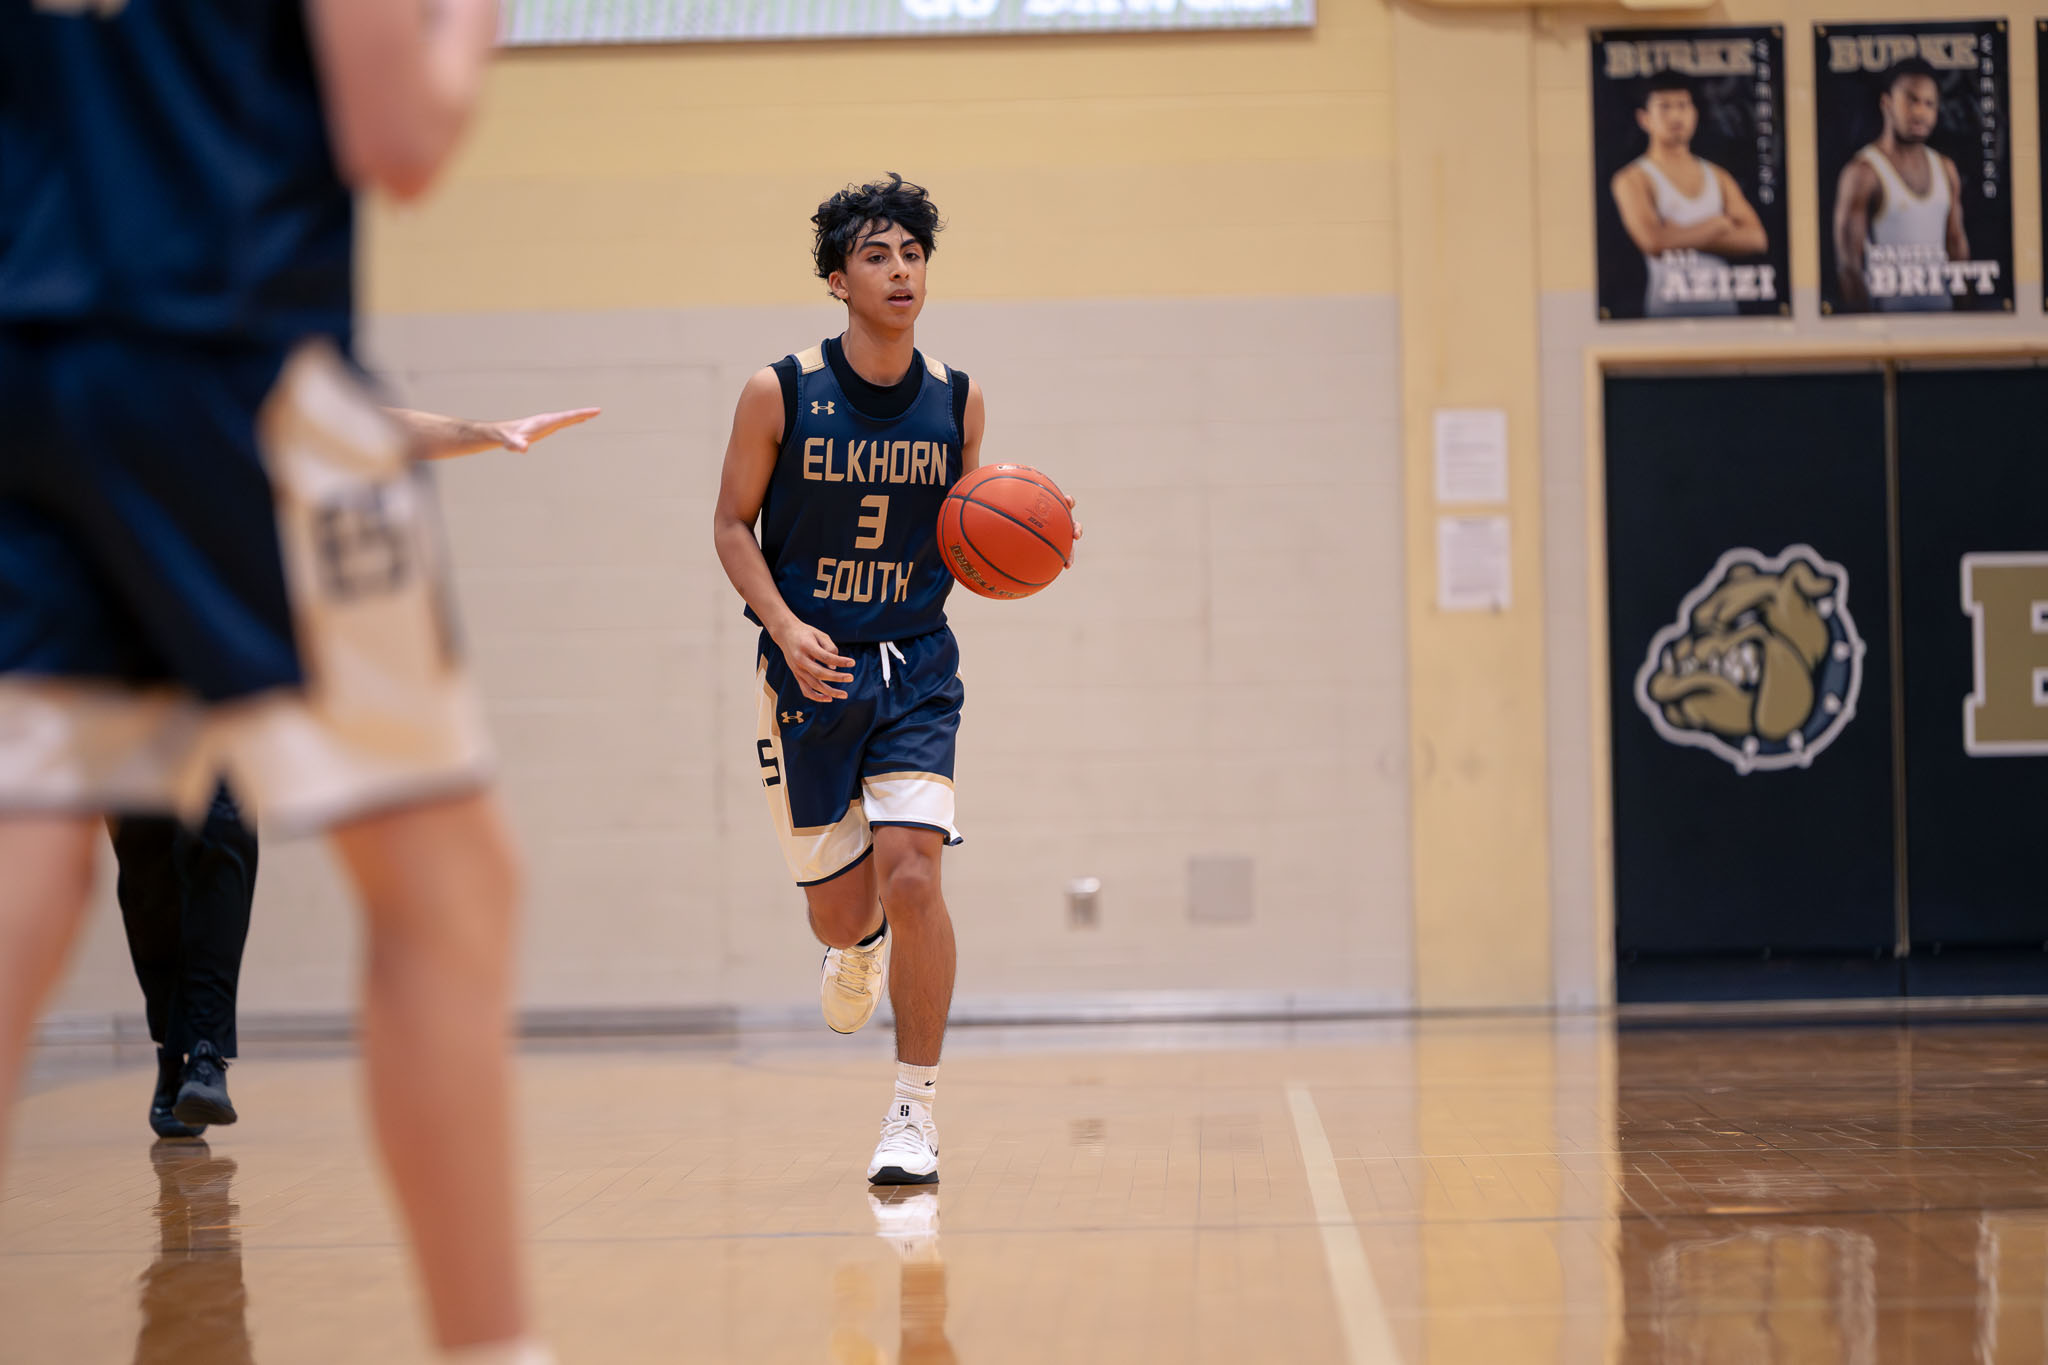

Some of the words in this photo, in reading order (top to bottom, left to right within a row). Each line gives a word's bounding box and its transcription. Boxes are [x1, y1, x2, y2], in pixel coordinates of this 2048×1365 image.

[1828, 33, 1978, 72] BURKE
[1661, 264, 1776, 302] AZIZI
[1867, 260, 2000, 298] BRITT
[803, 437, 947, 486] ELKHORN
[855, 494, 890, 550] 3
[813, 557, 914, 603] SOUTH
